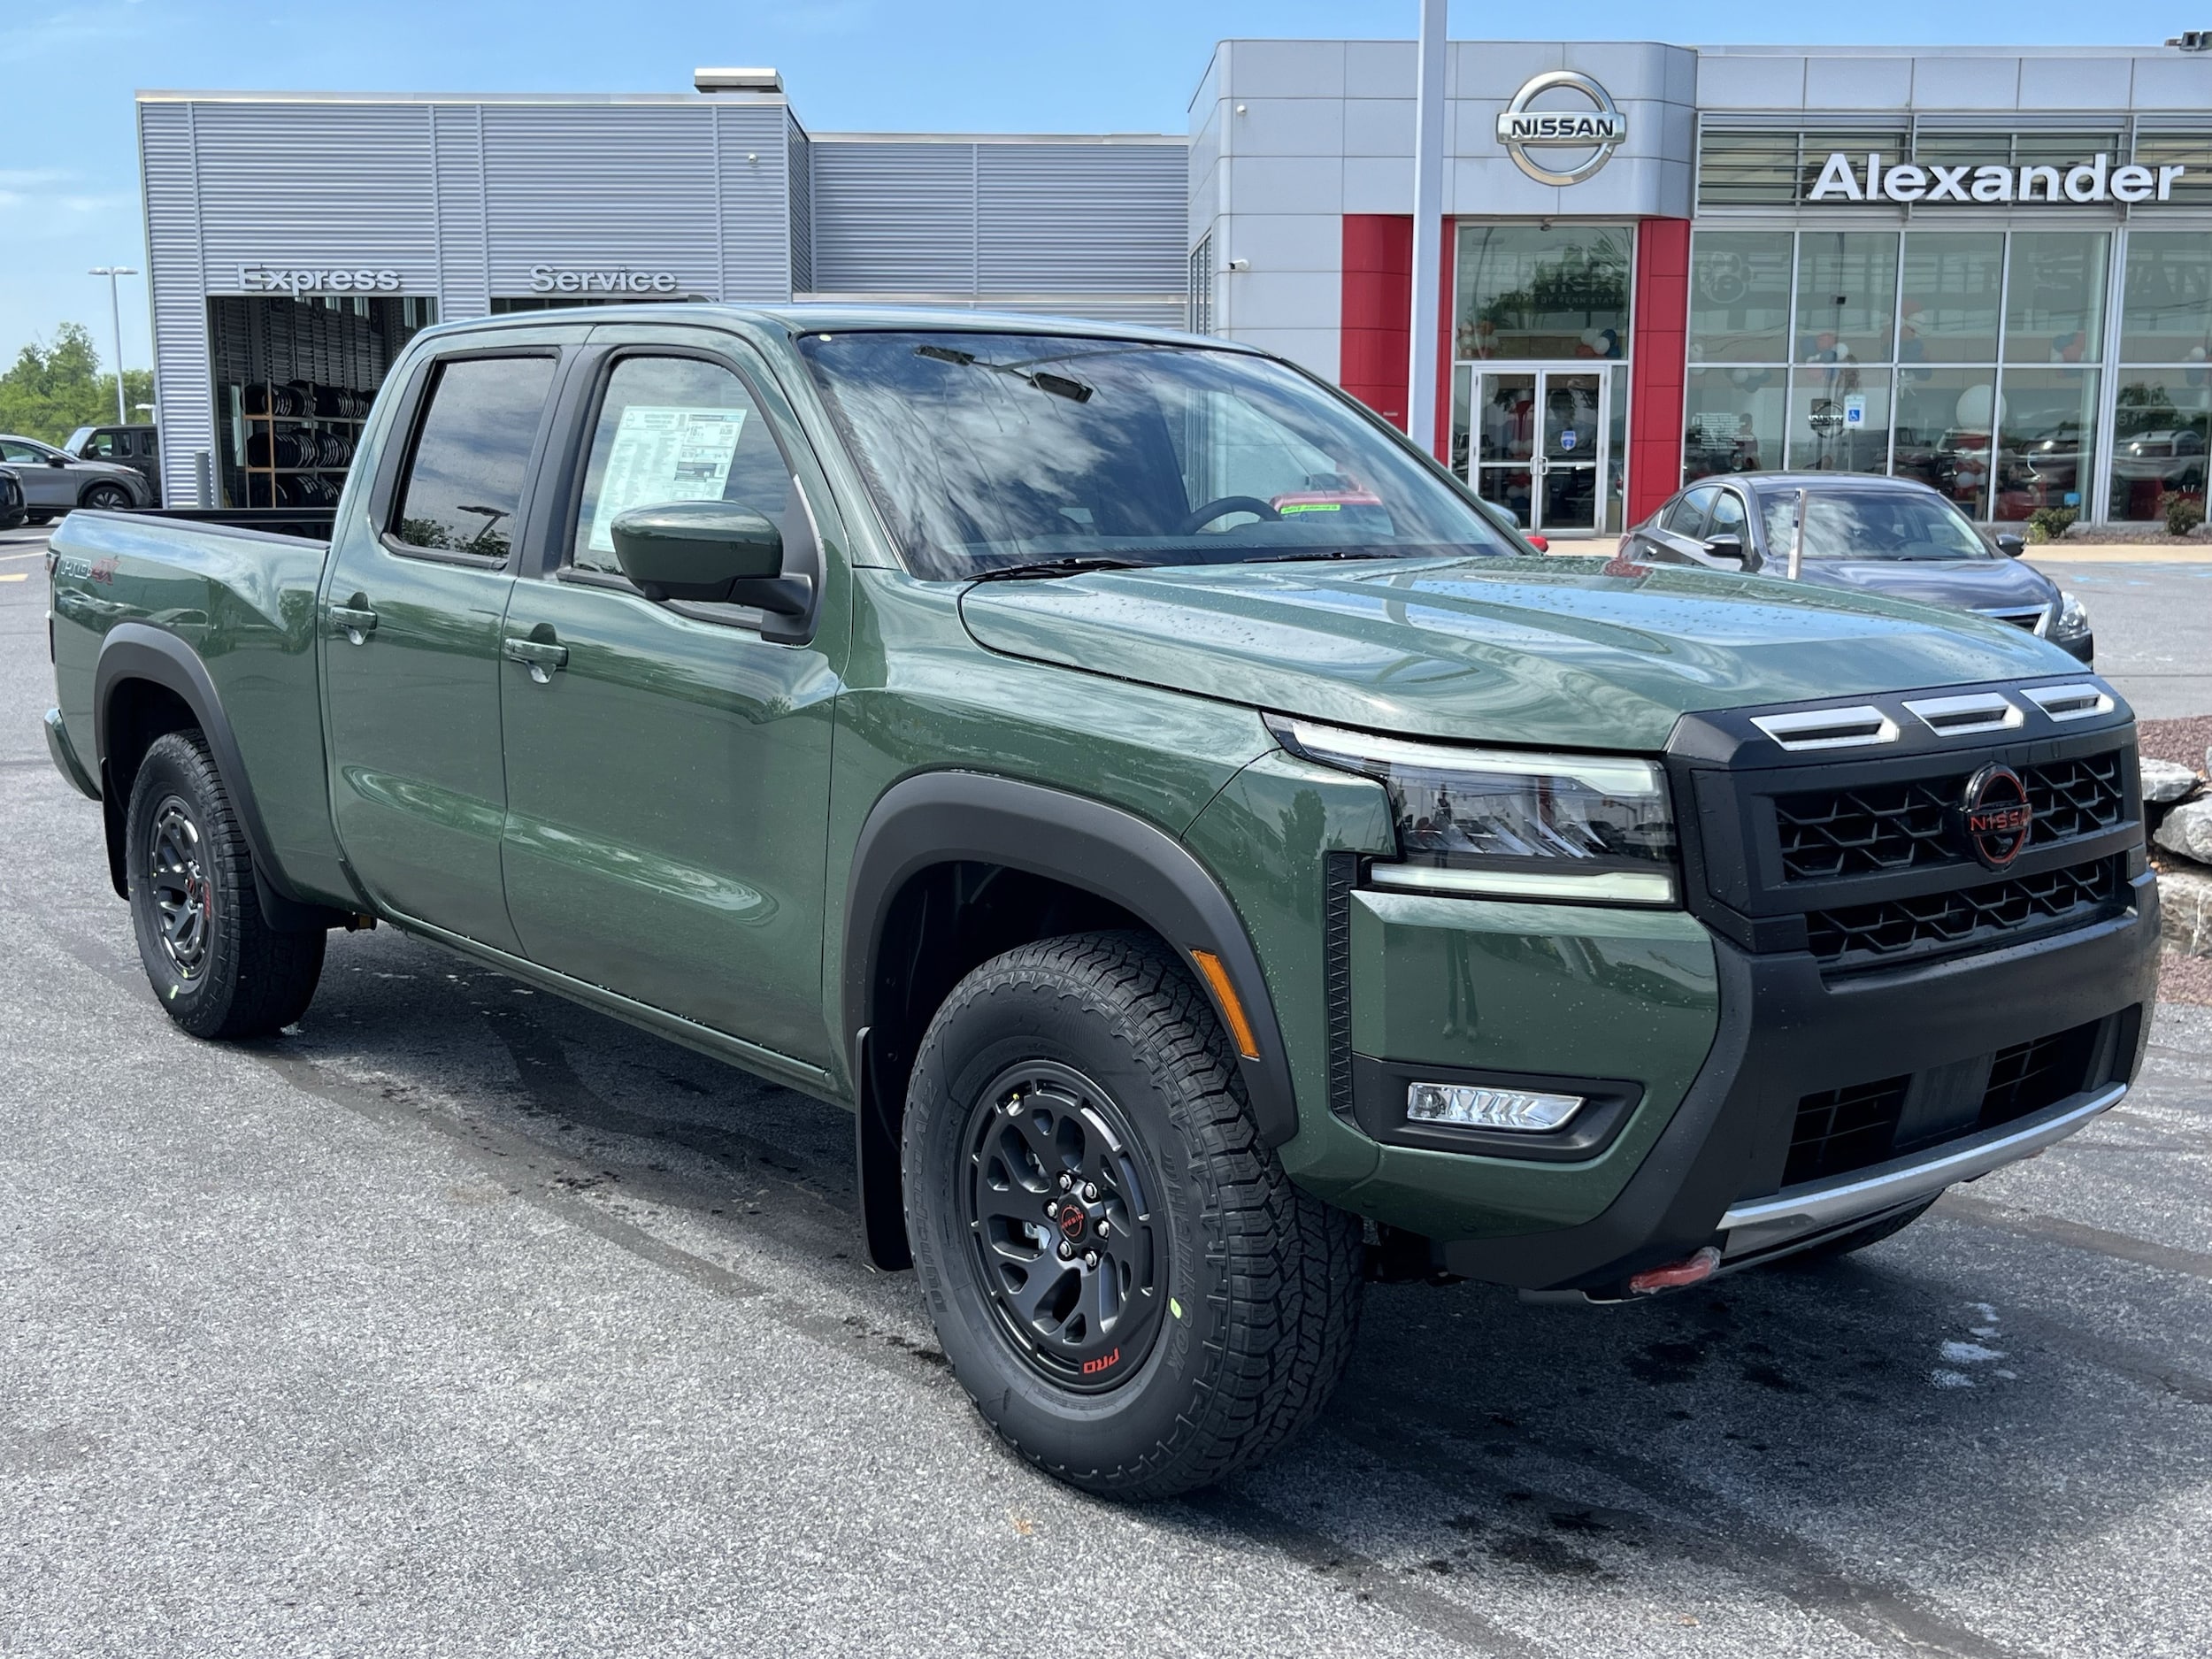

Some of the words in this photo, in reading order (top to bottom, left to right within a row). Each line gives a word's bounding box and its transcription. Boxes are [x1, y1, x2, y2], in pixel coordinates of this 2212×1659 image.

[1512, 119, 1614, 136] NISSAN
[1809, 153, 2185, 203] Alexander
[237, 264, 399, 296] Express
[531, 265, 676, 292] Service
[1083, 1347, 1119, 1373] PRO
